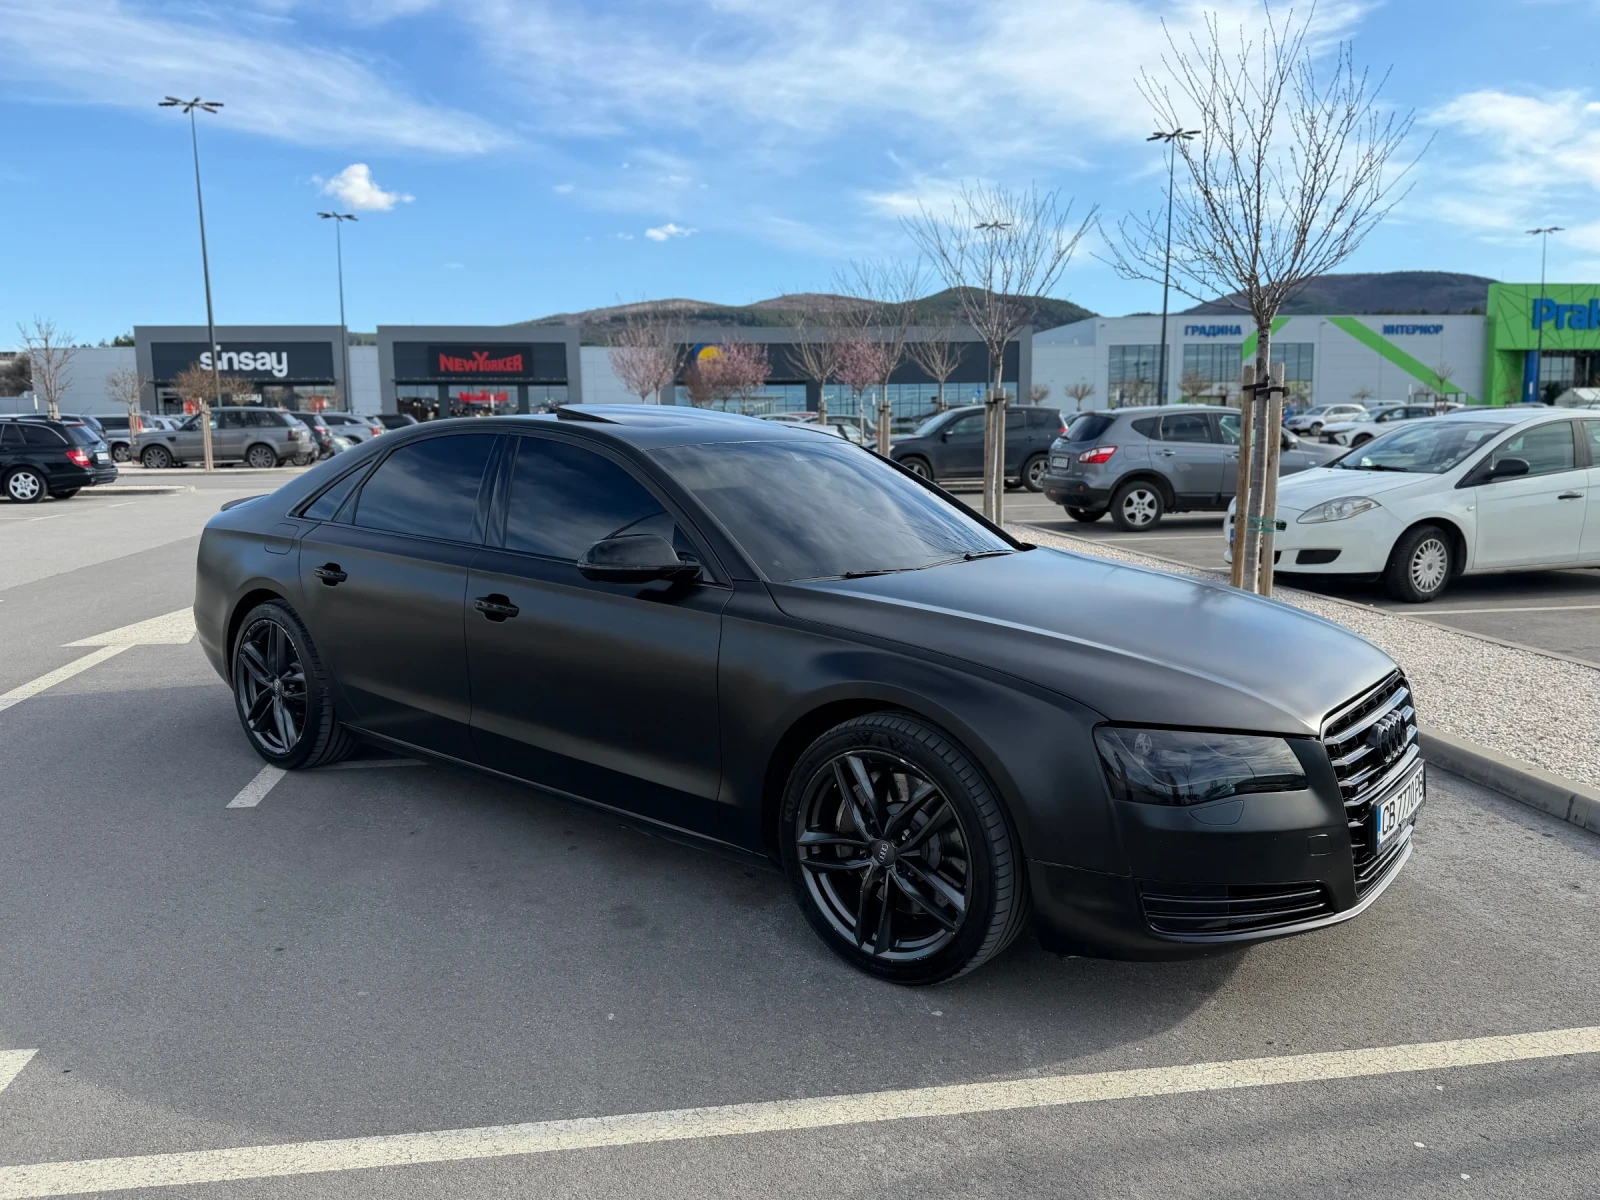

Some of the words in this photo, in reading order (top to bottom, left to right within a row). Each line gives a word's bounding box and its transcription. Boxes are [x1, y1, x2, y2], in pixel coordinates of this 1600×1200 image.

[1185, 324, 1242, 337] ГРАДИНА
[1383, 324, 1444, 335] ИНТЕРИОР
[1383, 801, 1395, 835] CB
